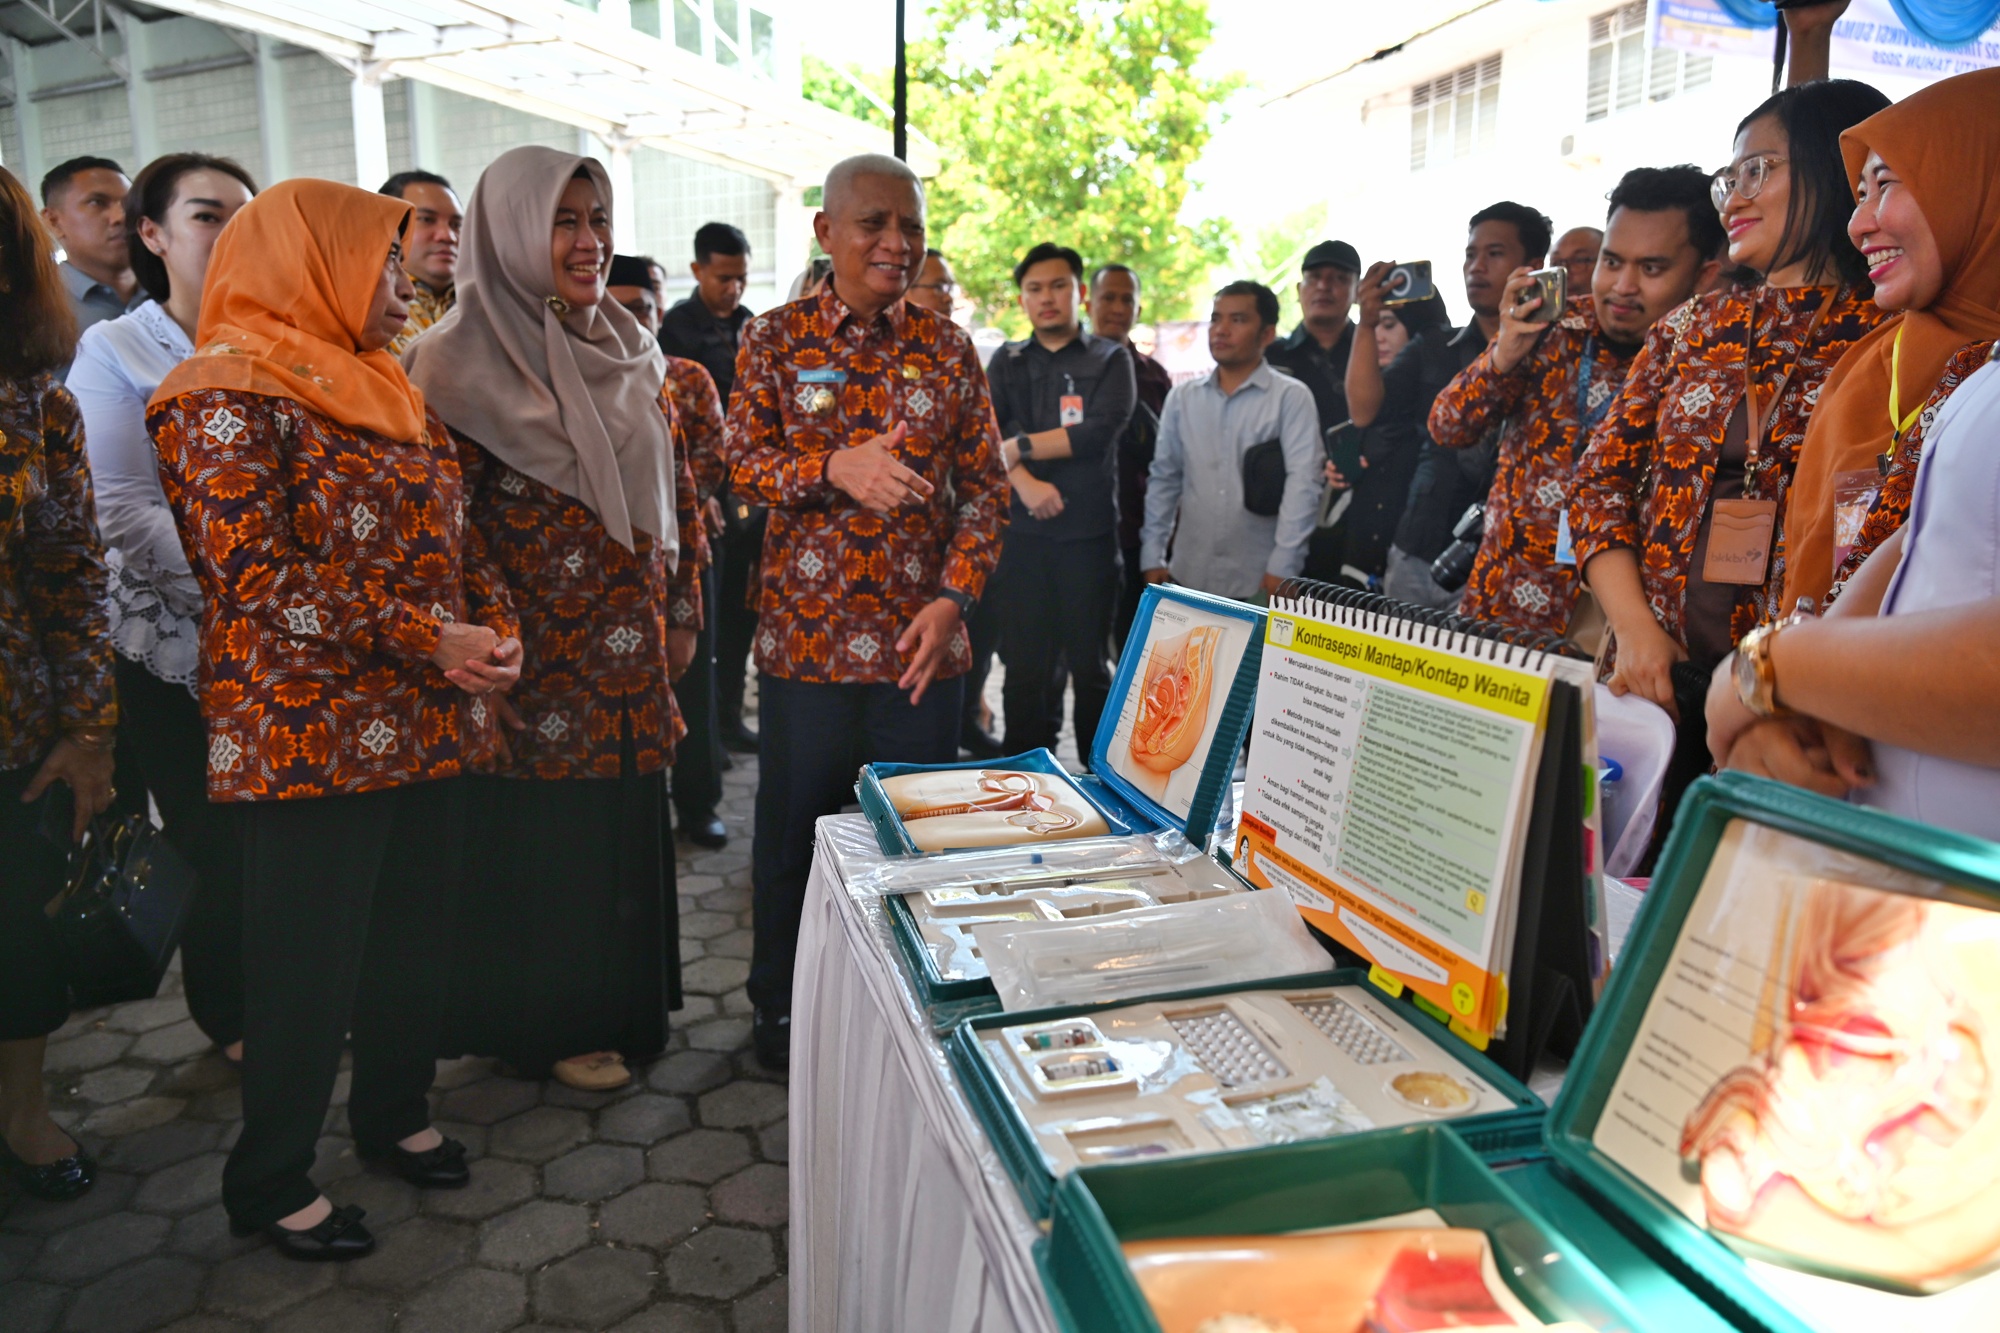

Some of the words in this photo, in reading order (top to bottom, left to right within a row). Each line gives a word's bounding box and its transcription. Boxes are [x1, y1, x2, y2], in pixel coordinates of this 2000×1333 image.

[1288, 658, 1313, 671] Merupakan
[1315, 666, 1333, 677] tindakan
[1334, 673, 1352, 684] operasi
[1296, 627, 1362, 659] Kontrasepsi
[1364, 645, 1469, 692] Mantap/Kontap
[1474, 674, 1530, 706] Wanita
[1274, 672, 1288, 682] Rahim
[1290, 677, 1304, 687] TIDAK
[1334, 693, 1347, 703] masih
[1303, 697, 1312, 706] bisa
[1313, 701, 1333, 715] mendapat
[1334, 710, 1345, 719] haid
[1271, 718, 1299, 734] dikembalikan
[1300, 729, 1305, 737] ke
[1287, 709, 1302, 720] Metode
[1303, 717, 1314, 727] yang
[1315, 720, 1325, 730] tidak
[1326, 726, 1341, 737] mudah
[1263, 729, 1275, 738] untuk
[1283, 739, 1294, 749] yang
[1295, 742, 1305, 752] tidak
[1300, 780, 1315, 793] Sangat
[1313, 768, 1323, 777] anak
[1324, 773, 1333, 783] lagi
[1267, 777, 1279, 788] Aman
[1280, 785, 1290, 795] bagi
[1290, 790, 1304, 802] hampir
[1305, 799, 1319, 811] semua
[1319, 806, 1327, 815] ibu
[1262, 790, 1272, 801] Tidak
[1273, 797, 1281, 806] ada
[1291, 807, 1309, 823] samping
[1309, 817, 1324, 831] jangka
[1260, 811, 1270, 822] Tidak
[1271, 819, 1294, 837] melindungi
